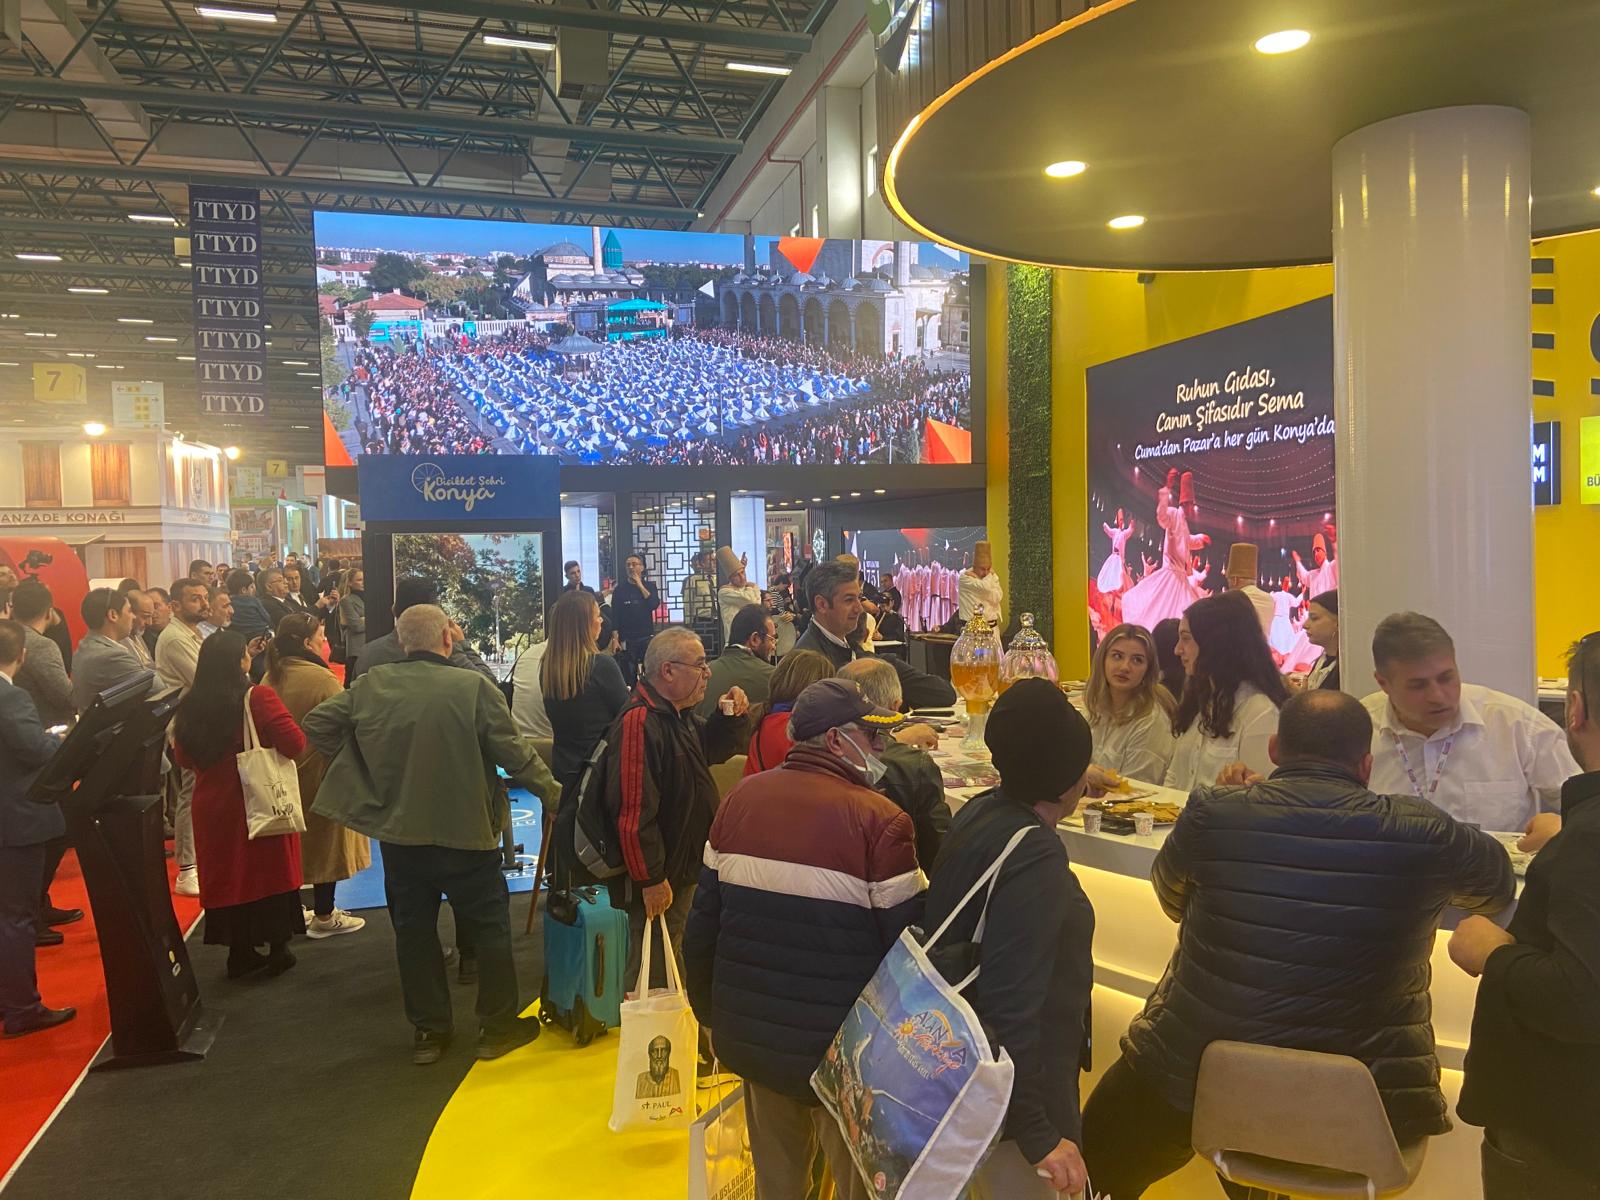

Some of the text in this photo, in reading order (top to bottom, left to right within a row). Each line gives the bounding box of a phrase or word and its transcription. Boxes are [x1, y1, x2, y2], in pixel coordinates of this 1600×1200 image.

[193, 201, 256, 221] TTYD
[194, 233, 257, 253] TTYD
[195, 265, 258, 285] TTYD
[197, 298, 260, 317] TTYD
[198, 330, 261, 349] TTYD
[46, 371, 61, 392] 7
[200, 362, 263, 381] TTYD
[1176, 365, 1276, 404] Ruhun Gıdası,
[202, 394, 265, 413] TTYD
[1156, 391, 1305, 433] Canın Şifasıdır Sema
[1134, 414, 1336, 460] Cuma'dan Pazar'a her gün Konya'da
[272, 463, 280, 474] 7
[423, 479, 496, 512] Konya
[1, 510, 126, 523] ANZADE KONAĞI
